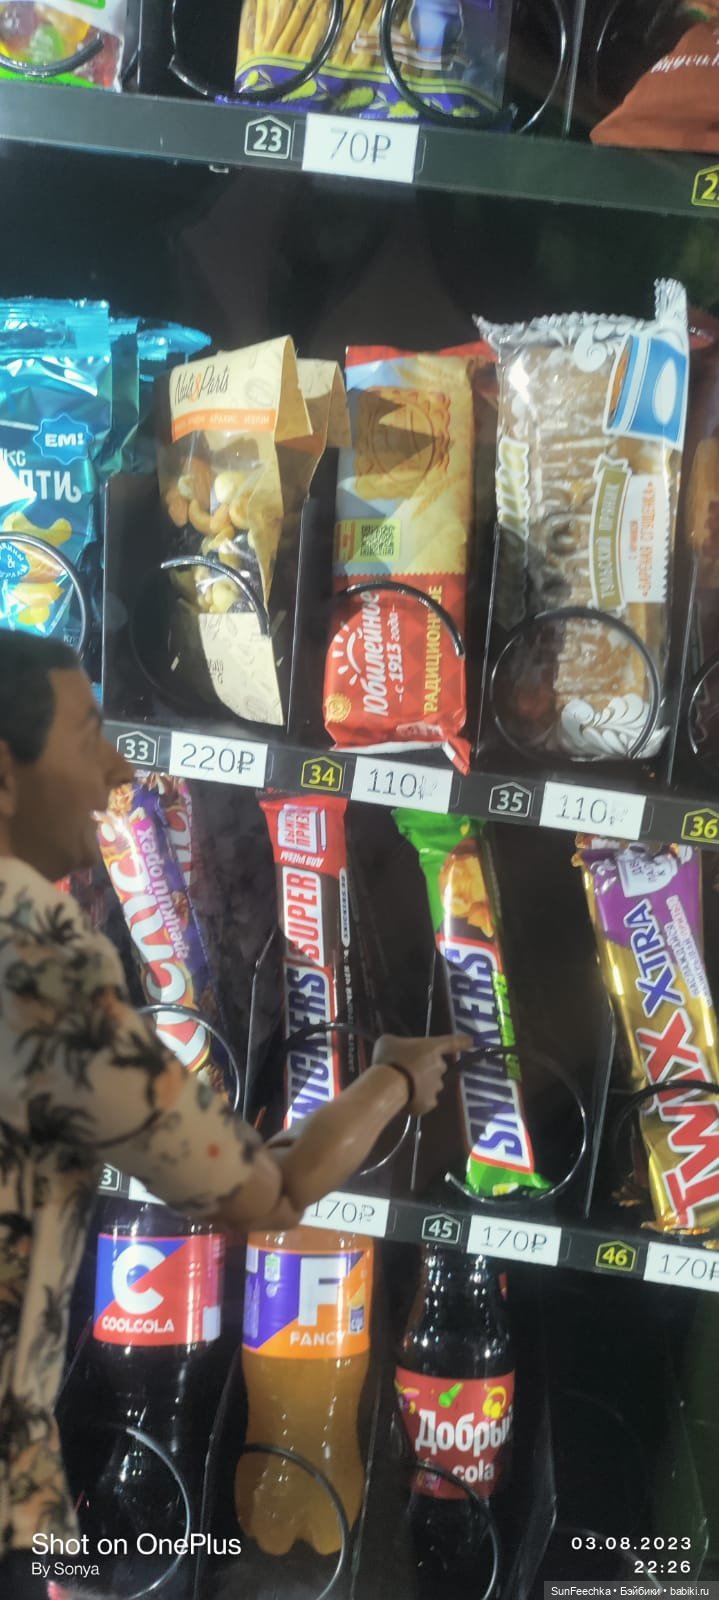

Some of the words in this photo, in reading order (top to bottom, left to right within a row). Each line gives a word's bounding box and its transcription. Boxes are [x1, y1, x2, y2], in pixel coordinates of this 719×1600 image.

[252, 124, 282, 152] 23
[330, 128, 391, 164] 70₽
[702, 172, 719, 201] 2
[357, 590, 389, 716] Юбилейное
[388, 643, 404, 681] 1913
[424, 585, 442, 716] РАДИЦИОНОЕ
[124, 739, 149, 761] 33
[180, 743, 256, 774] 220₽
[309, 765, 336, 787] 34
[499, 789, 523, 812] 35
[690, 817, 718, 839] 36
[137, 826, 164, 880] орех
[286, 873, 320, 961] SUPER
[625, 901, 684, 1017] XTRA
[286, 967, 331, 1129] NICKERS
[637, 1010, 719, 1228] TWIX
[101, 1168, 112, 1186] 3
[309, 1198, 376, 1223] 170₽
[428, 1221, 453, 1239] 45
[481, 1225, 548, 1253] 170₽
[602, 1249, 628, 1266] 46
[102, 1315, 175, 1333] COOLCOLA
[290, 1330, 346, 1346] FANCY
[453, 1459, 495, 1483] cola
